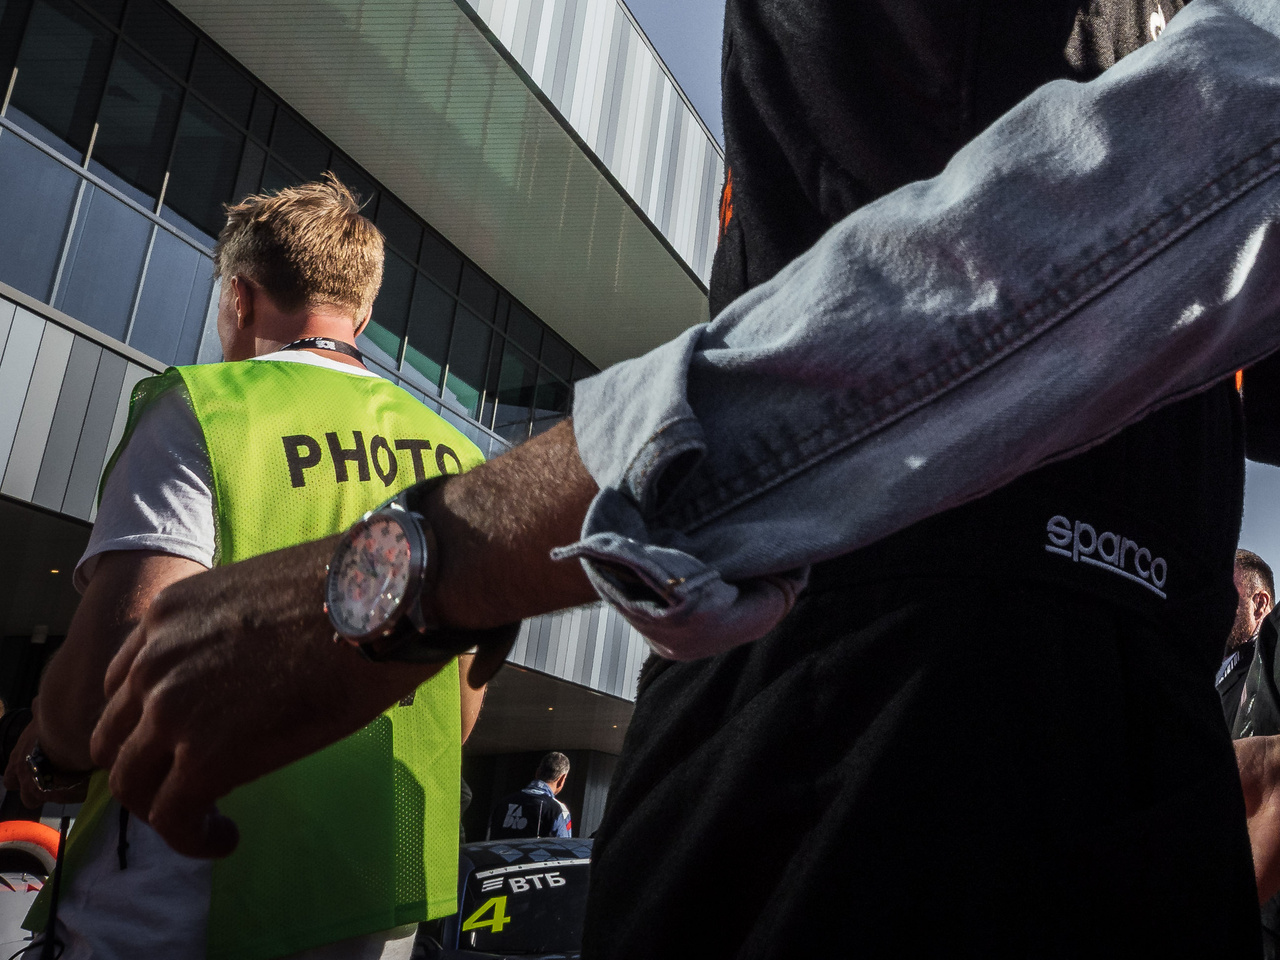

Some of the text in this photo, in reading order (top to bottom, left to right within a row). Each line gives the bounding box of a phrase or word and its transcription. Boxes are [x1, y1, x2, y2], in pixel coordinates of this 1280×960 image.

[281, 429, 463, 489] PHOTO
[1045, 514, 1168, 590] sparco
[508, 871, 567, 894] ВТБ
[462, 895, 511, 934] 4
